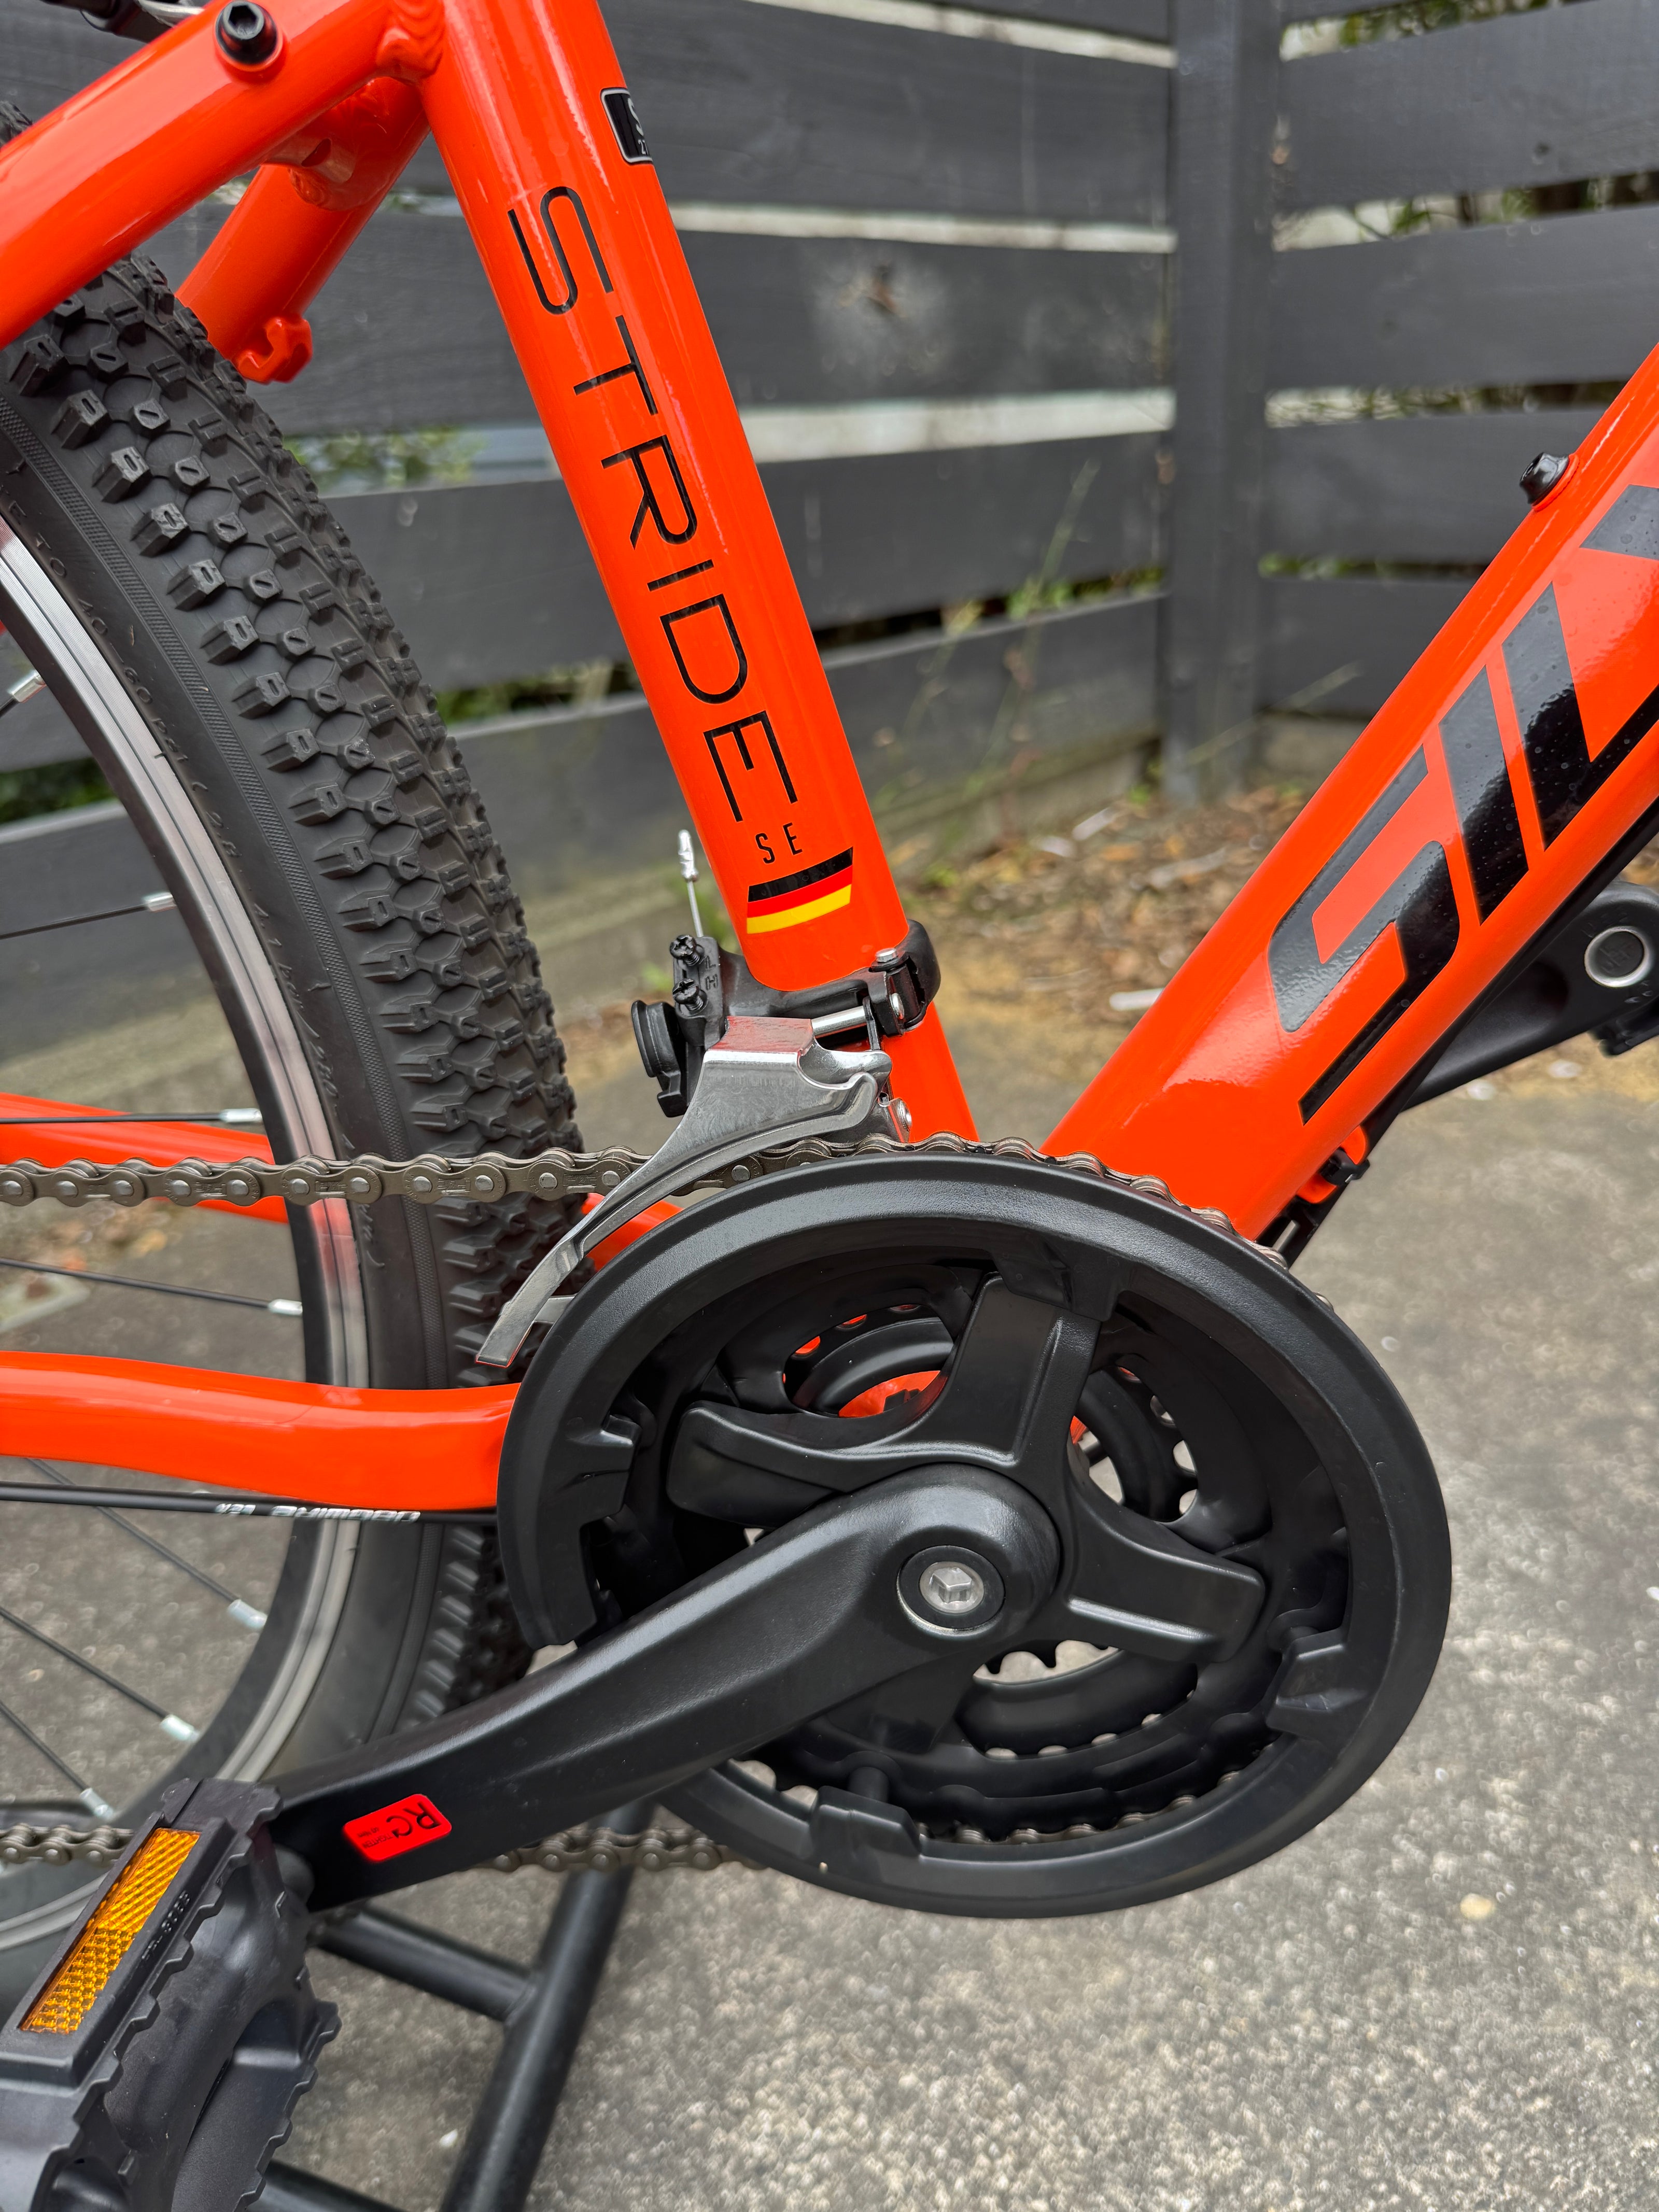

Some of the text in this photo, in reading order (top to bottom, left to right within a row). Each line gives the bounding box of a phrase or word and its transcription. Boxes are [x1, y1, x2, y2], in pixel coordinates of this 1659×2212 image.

[509, 186, 798, 823] STRIDE
[755, 822, 803, 864] SE
[706, 974, 718, 991] H
